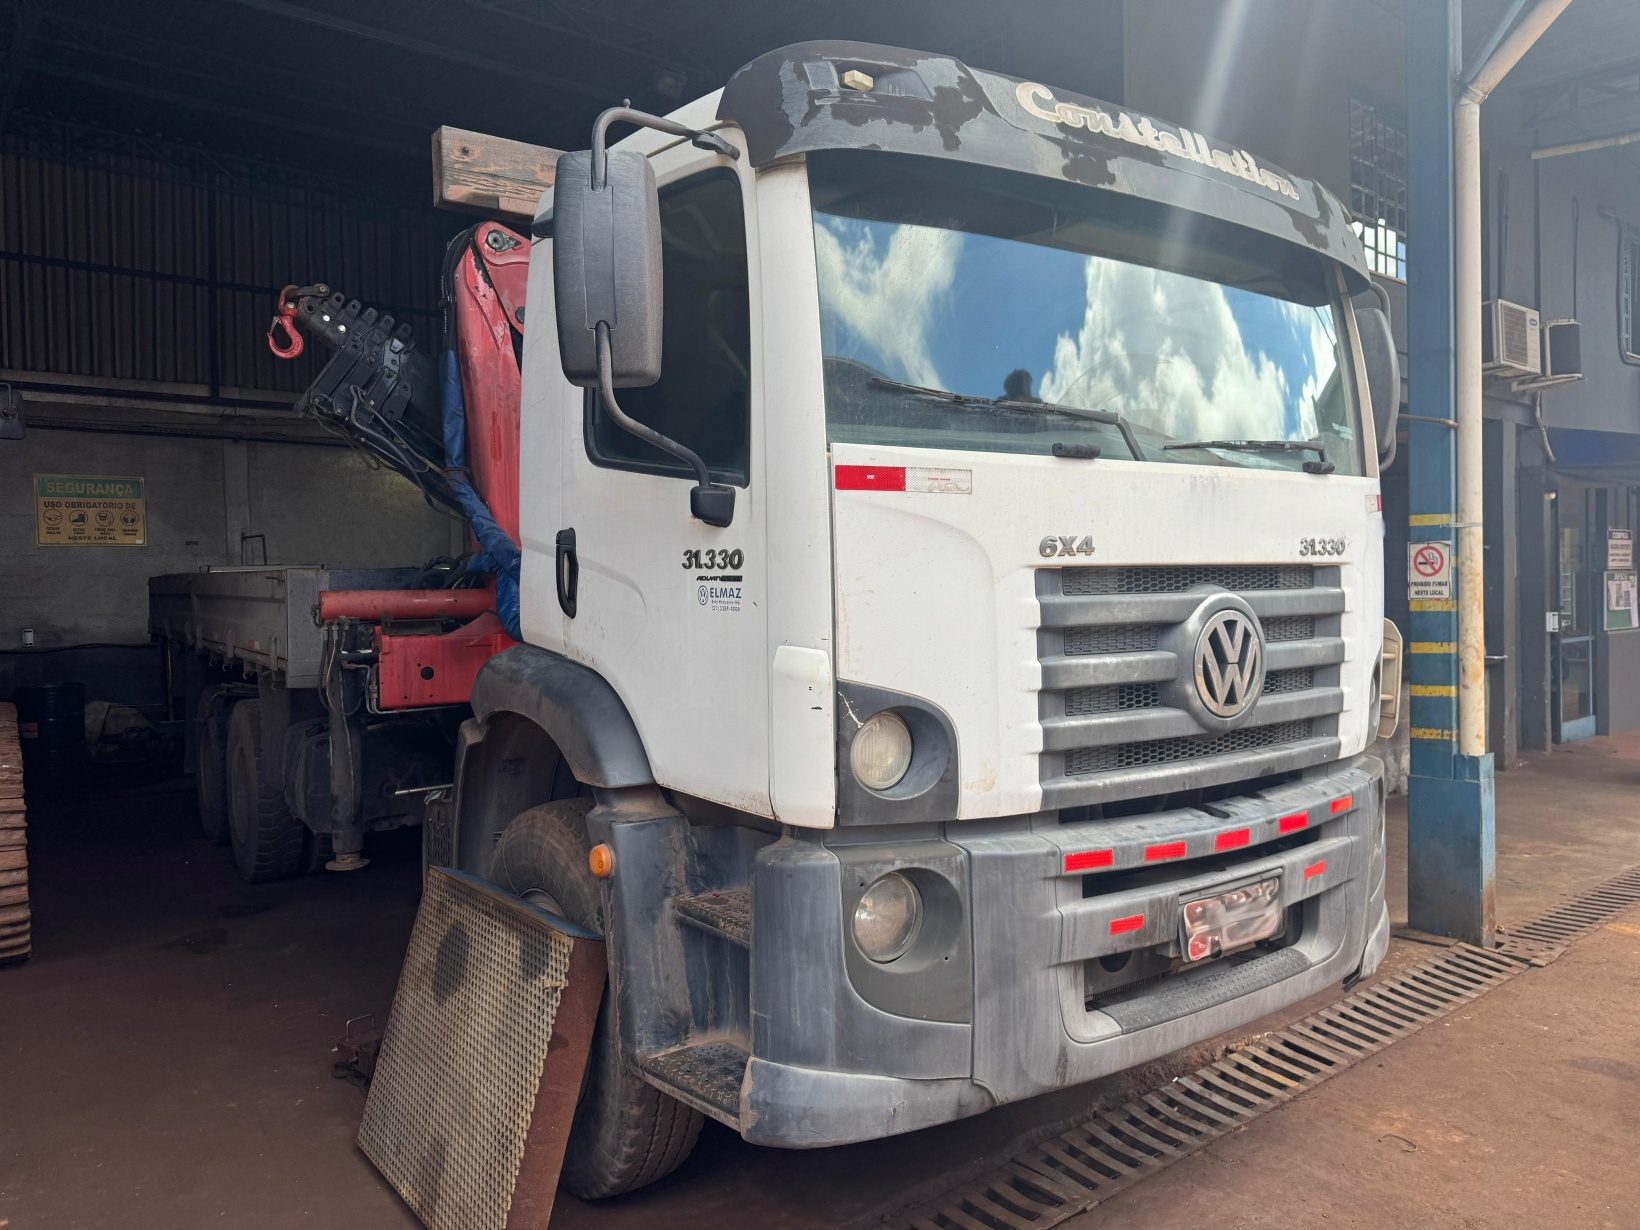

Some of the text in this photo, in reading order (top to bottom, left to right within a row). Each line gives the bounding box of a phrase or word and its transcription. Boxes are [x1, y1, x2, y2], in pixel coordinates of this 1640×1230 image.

[1015, 81, 1300, 201] Constellation
[47, 482, 134, 497] SEGURANÇA
[64, 501, 123, 509] OBRIGATÓRIO
[1039, 535, 1095, 558] 6X4
[1299, 537, 1346, 556] 31.330
[682, 549, 744, 570] 31.330
[709, 587, 742, 599] ELMAZ
